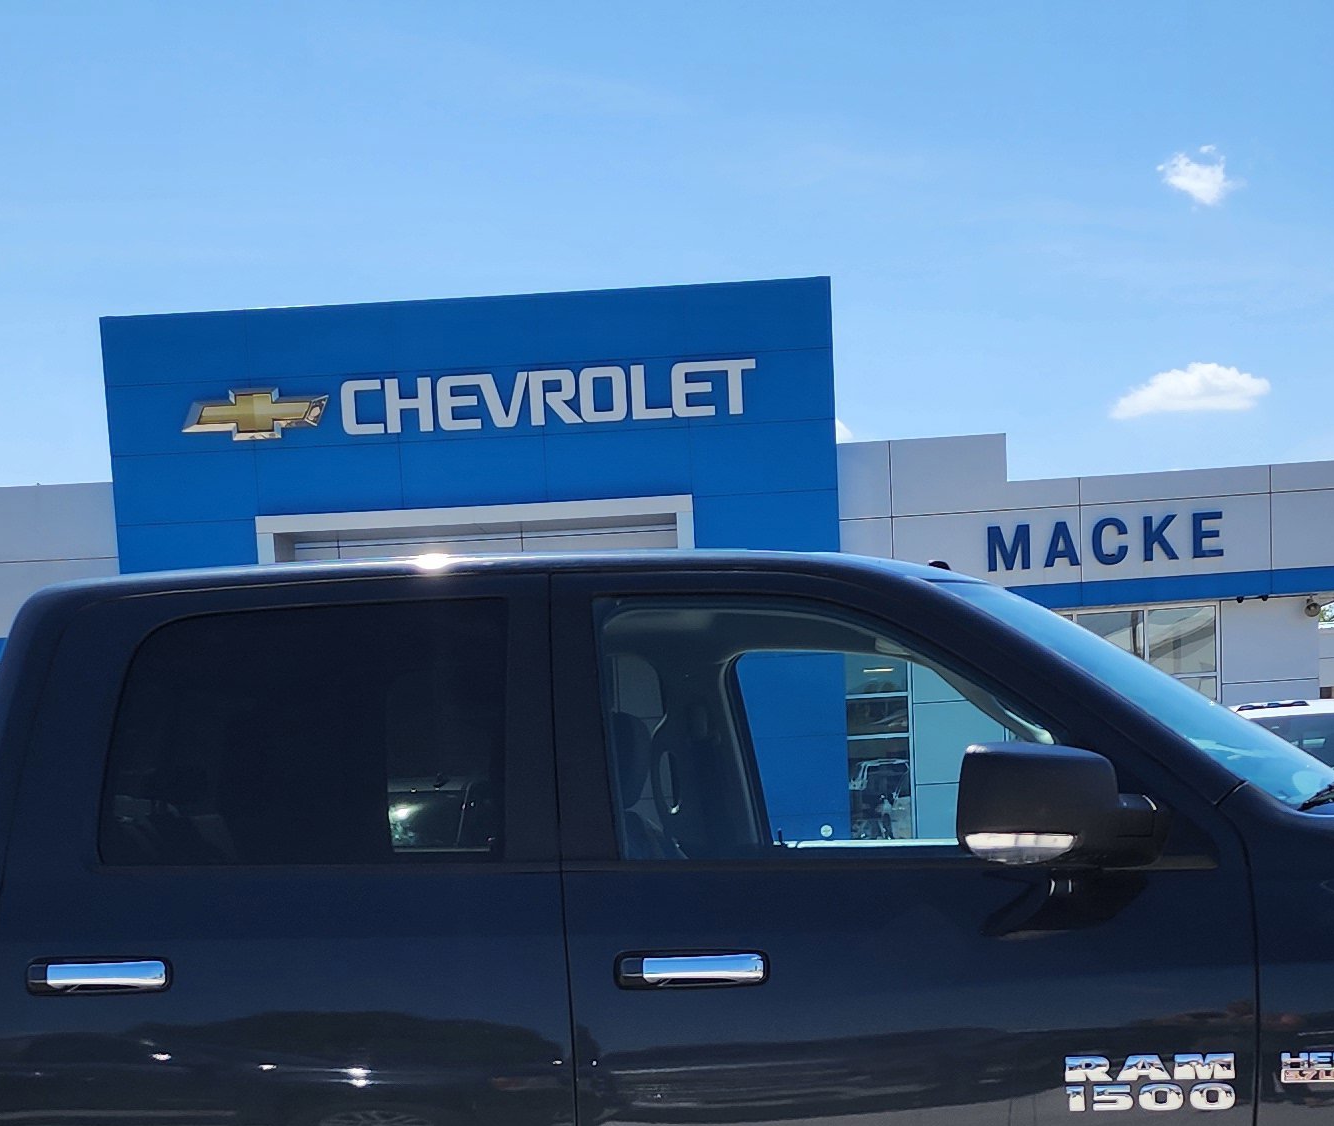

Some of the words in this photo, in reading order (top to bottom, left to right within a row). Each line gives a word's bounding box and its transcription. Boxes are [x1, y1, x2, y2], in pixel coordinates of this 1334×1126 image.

[340, 358, 757, 436] CHEVROLET
[986, 510, 1225, 573] MACKE
[1064, 1052, 1236, 1082] RAM
[1065, 1082, 1236, 1112] 1500
